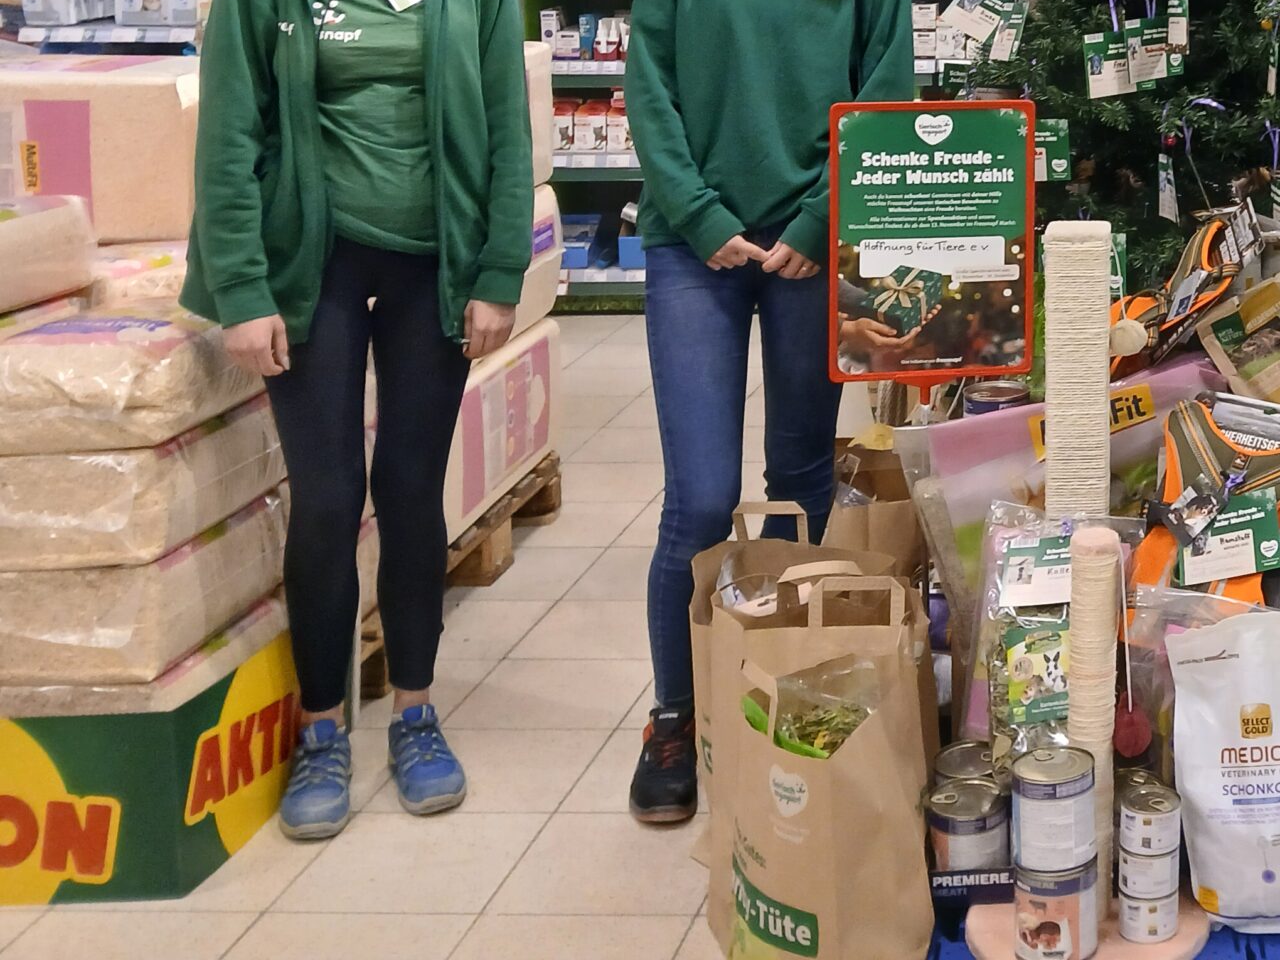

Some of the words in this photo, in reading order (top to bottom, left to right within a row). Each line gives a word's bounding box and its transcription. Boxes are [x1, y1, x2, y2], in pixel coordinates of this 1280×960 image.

[319, 29, 362, 42] snapf
[861, 152, 929, 167] Schenke
[933, 151, 992, 166] Freude
[851, 171, 901, 185] Jeder
[906, 169, 969, 184] Wunsch
[973, 168, 1014, 183] zählt
[864, 241, 913, 255] Hoffnung
[916, 242, 933, 250] für
[934, 241, 967, 251] Tiere
[1110, 395, 1146, 425] Fit
[1241, 717, 1270, 727] SELECT
[1244, 726, 1269, 735] GOLD
[189, 692, 299, 817] AKTI
[1221, 768, 1276, 778] VETERINARY
[932, 872, 1014, 887] PREMIERE.
